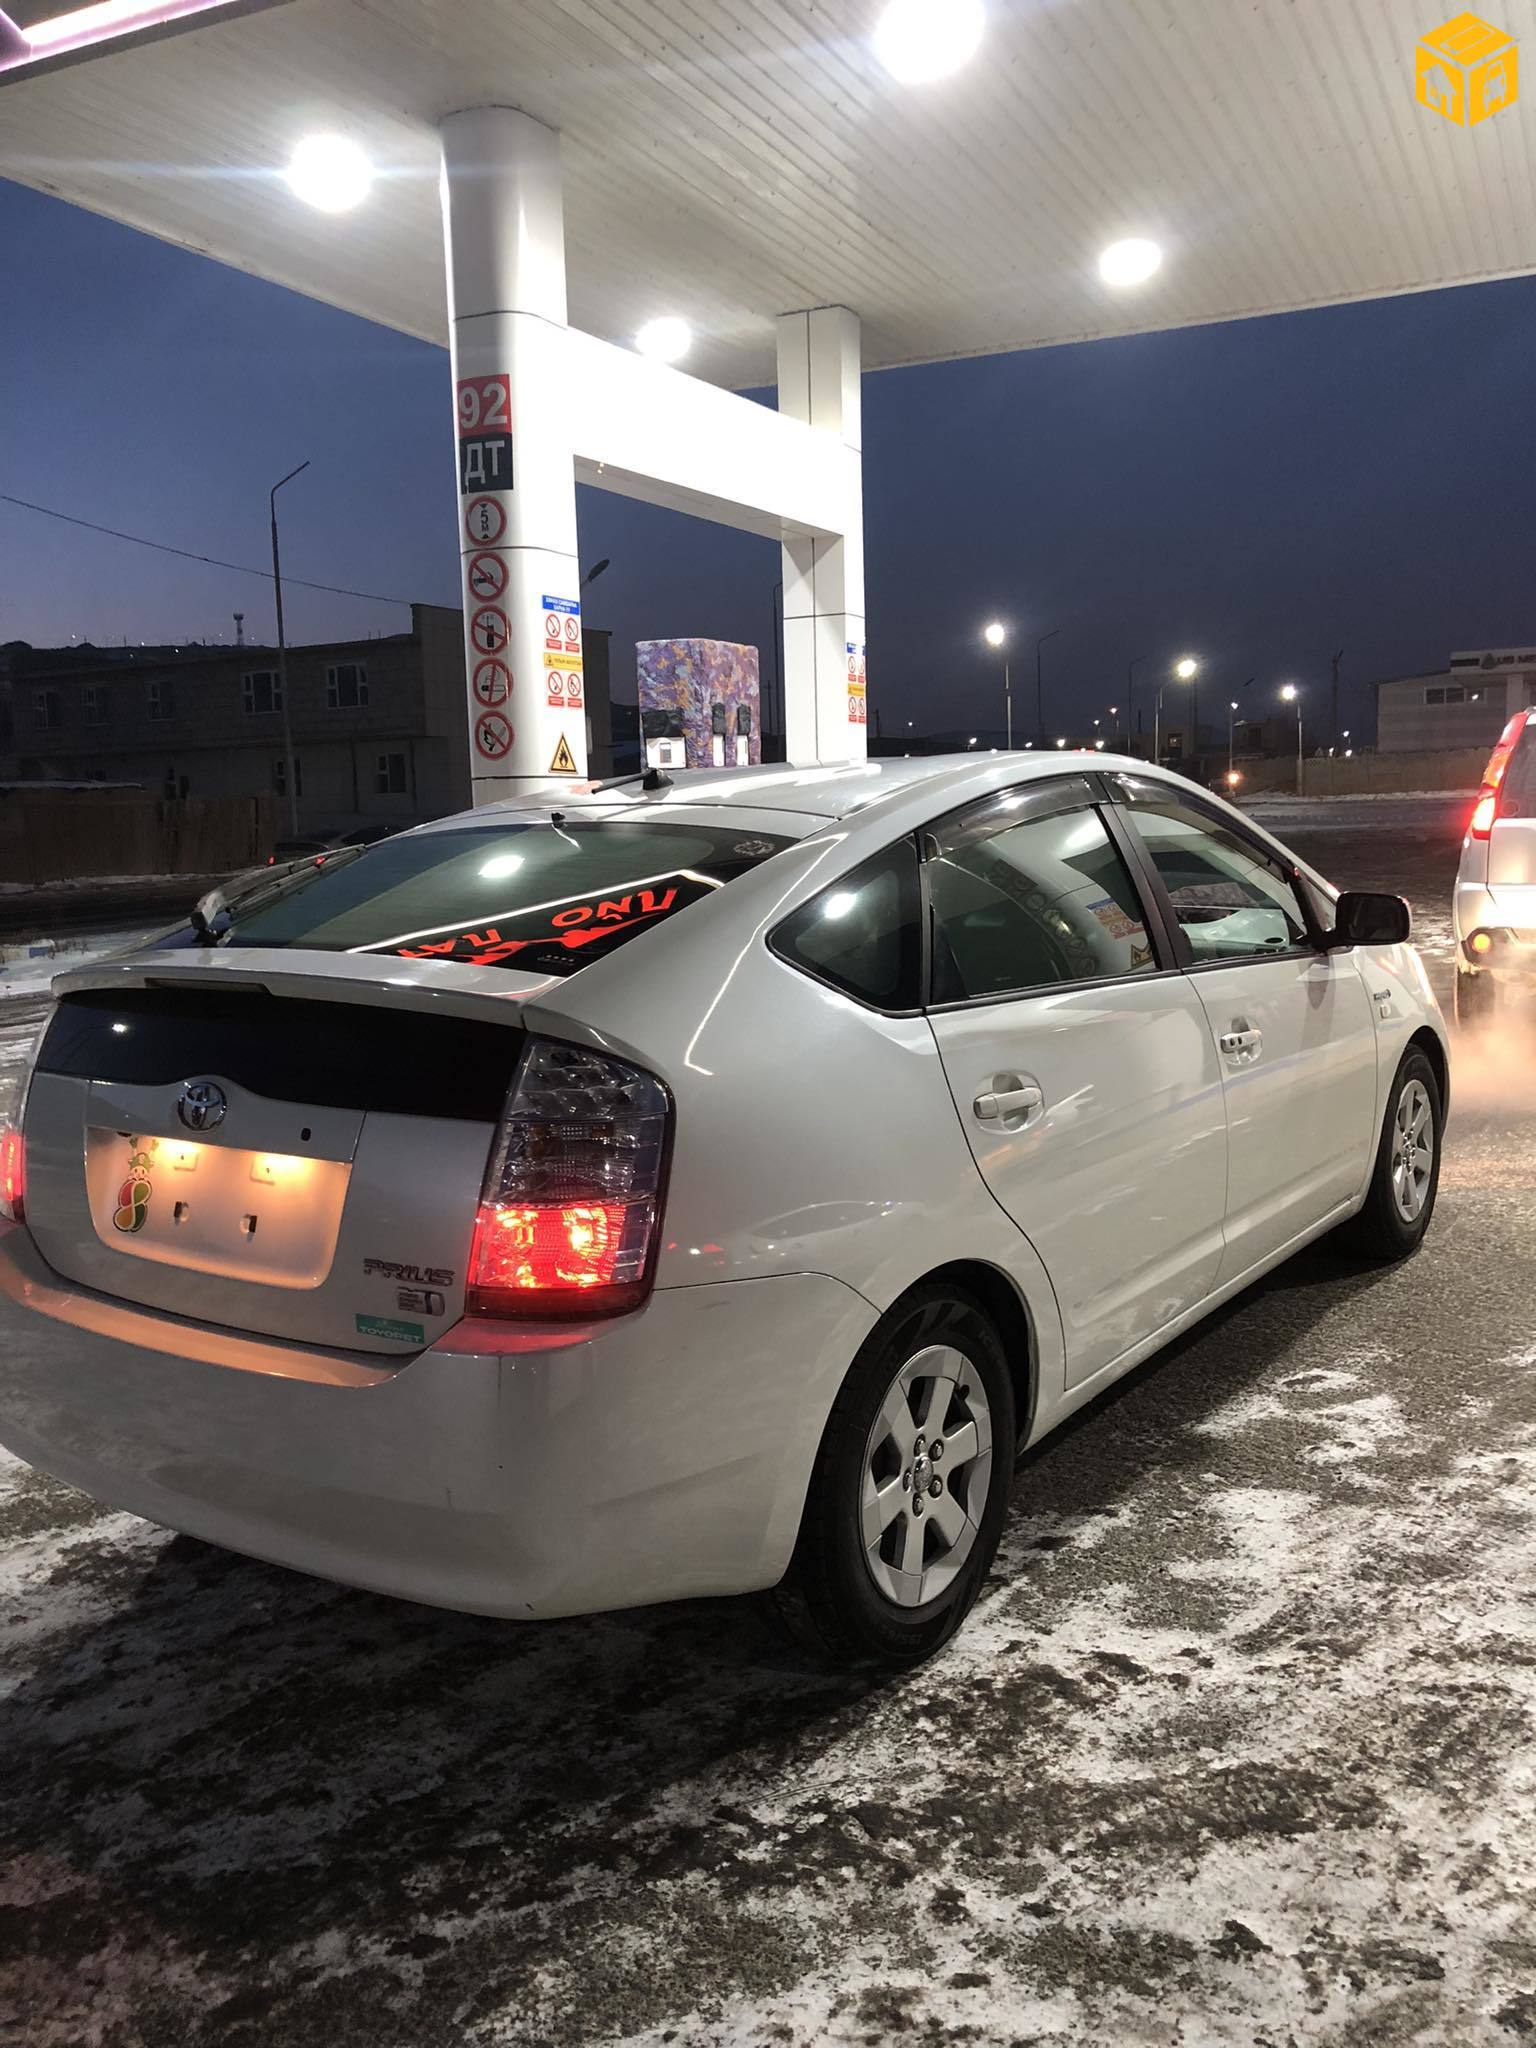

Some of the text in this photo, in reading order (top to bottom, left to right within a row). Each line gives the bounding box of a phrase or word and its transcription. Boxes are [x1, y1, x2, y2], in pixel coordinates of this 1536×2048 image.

[459, 382, 508, 429] 92
[464, 440, 505, 493] ДТ
[480, 509, 489, 524] 5
[364, 1258, 455, 1286] PRIUS
